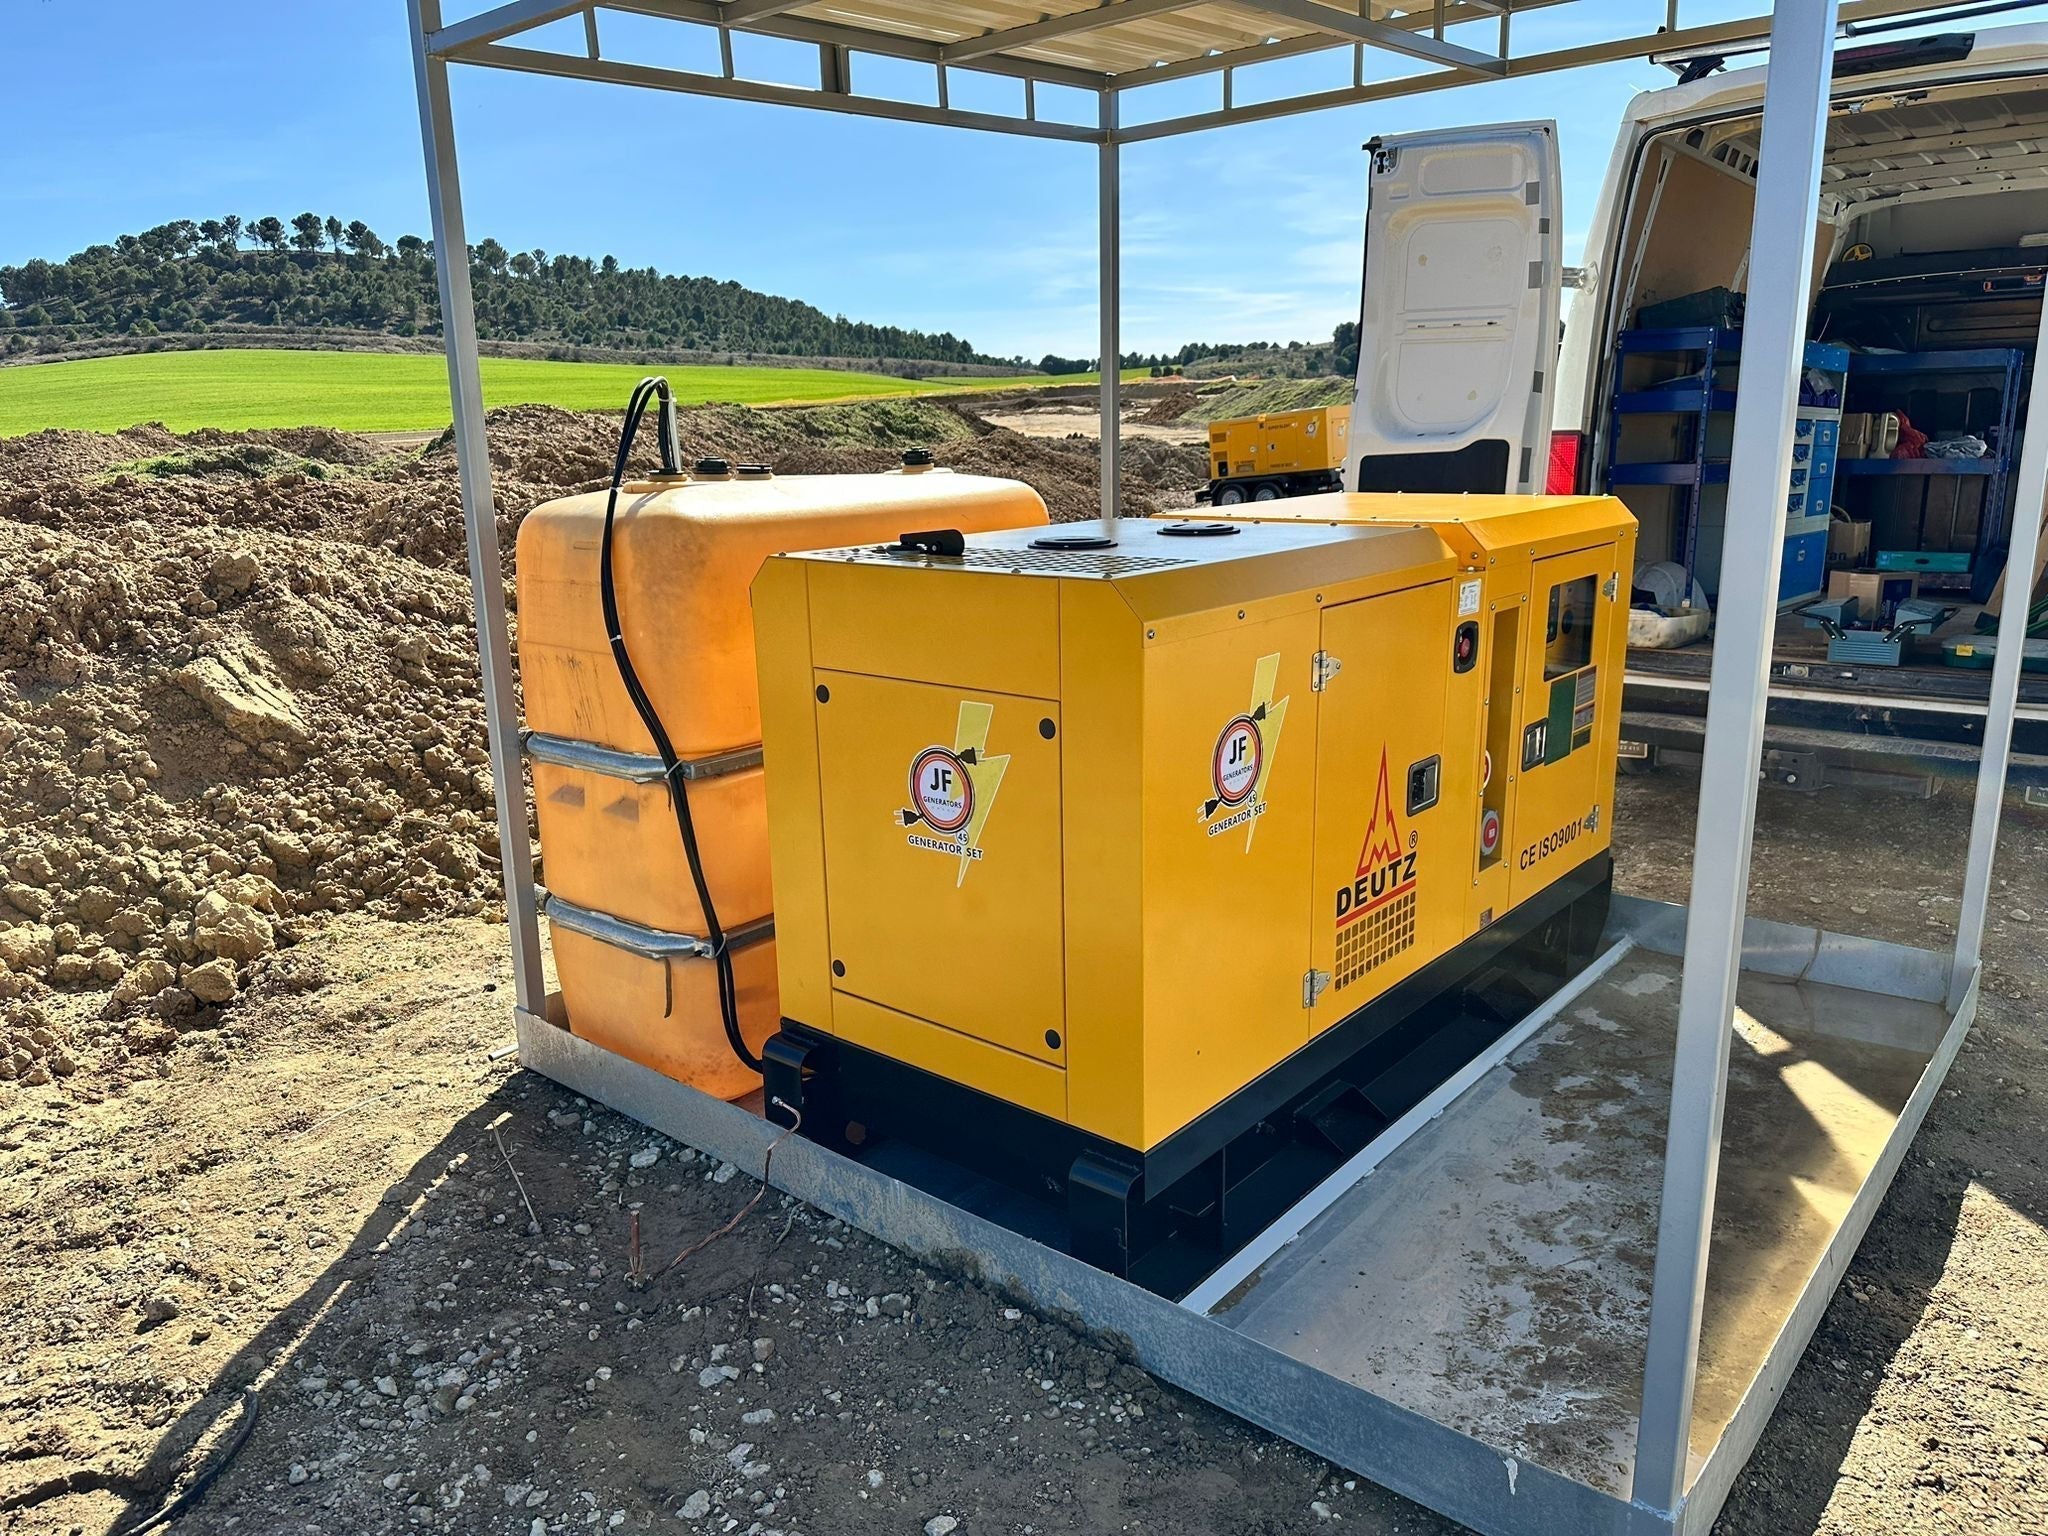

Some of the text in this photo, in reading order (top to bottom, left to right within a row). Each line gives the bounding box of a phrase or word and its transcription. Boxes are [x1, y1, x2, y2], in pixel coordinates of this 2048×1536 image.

[1229, 736, 1247, 764] JF
[930, 767, 952, 792] JF
[1223, 764, 1253, 782] GENERATORS
[923, 795, 962, 809] GENERATORS
[1208, 802, 1266, 835] GENERATOR SET
[908, 835, 983, 859] GENERATOR SET
[1520, 817, 1582, 870] CE ISO9001
[1336, 851, 1417, 918] DEUTZ
